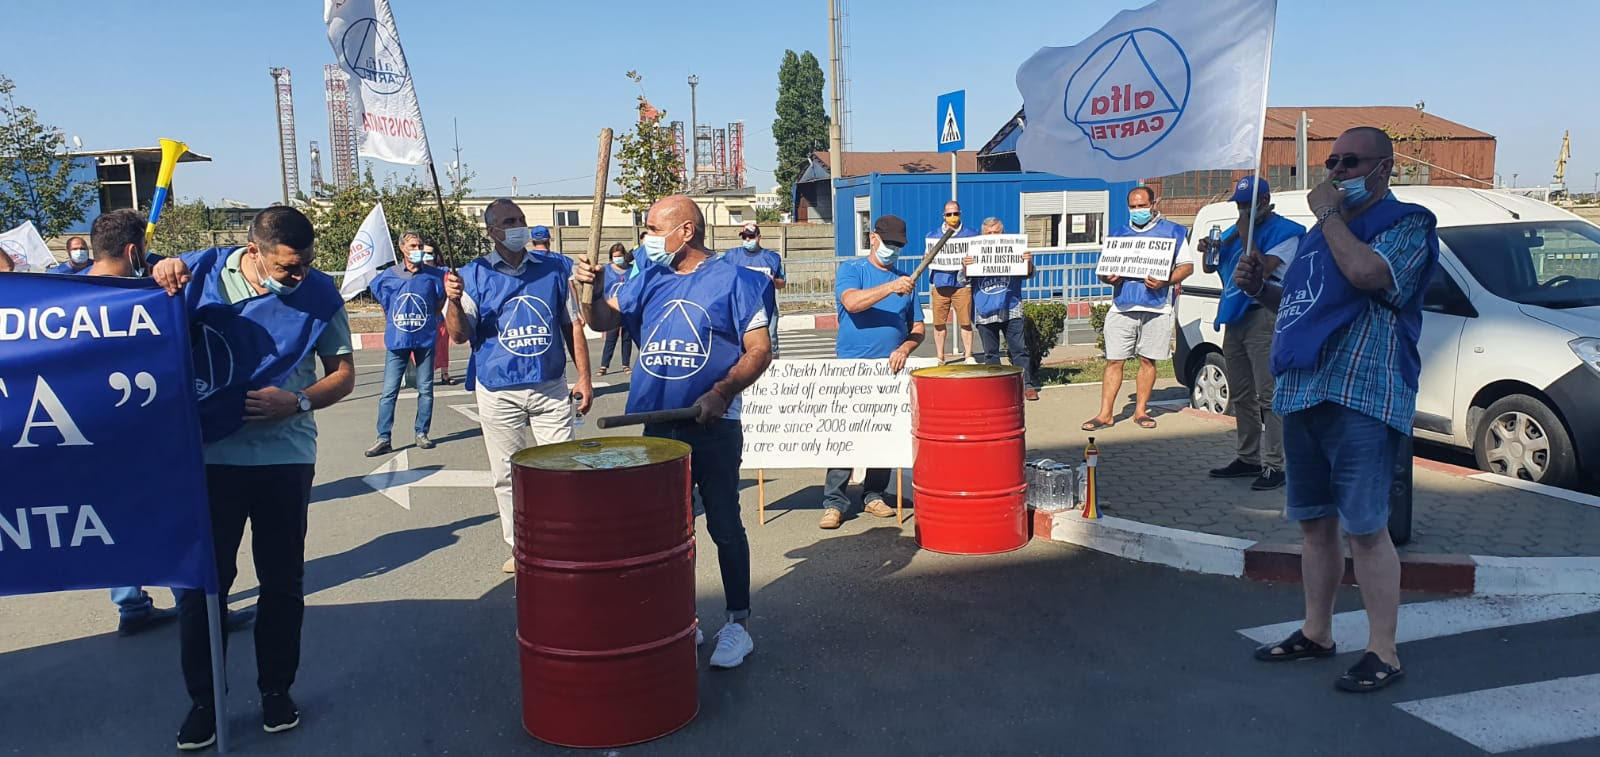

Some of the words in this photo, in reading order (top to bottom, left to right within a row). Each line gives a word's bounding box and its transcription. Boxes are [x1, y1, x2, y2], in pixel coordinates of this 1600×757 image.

[981, 246, 992, 254] NU
[996, 246, 1013, 254] UITA
[1135, 240, 1146, 249] de
[1148, 240, 1173, 251] CSCT
[995, 255, 1024, 264] DISTRUS
[507, 325, 548, 337] alfa
[508, 337, 548, 349] CARTEL
[648, 338, 699, 353] alfa
[646, 355, 699, 369] CARTEL
[782, 363, 817, 378] Sheikh
[819, 363, 857, 377] Ahmed
[857, 362, 874, 376] Bin
[752, 383, 768, 396] the
[770, 382, 779, 396] 3
[781, 382, 800, 396] laid
[801, 382, 815, 400] off
[818, 382, 873, 398] employees
[876, 381, 902, 394] want
[831, 399, 848, 413] the
[852, 403, 898, 417] company
[756, 419, 781, 433] done
[783, 421, 813, 433] since
[816, 418, 846, 433] 2008
[848, 418, 872, 433] until
[753, 442, 774, 452] are
[778, 442, 799, 452] our
[801, 437, 822, 456] only
